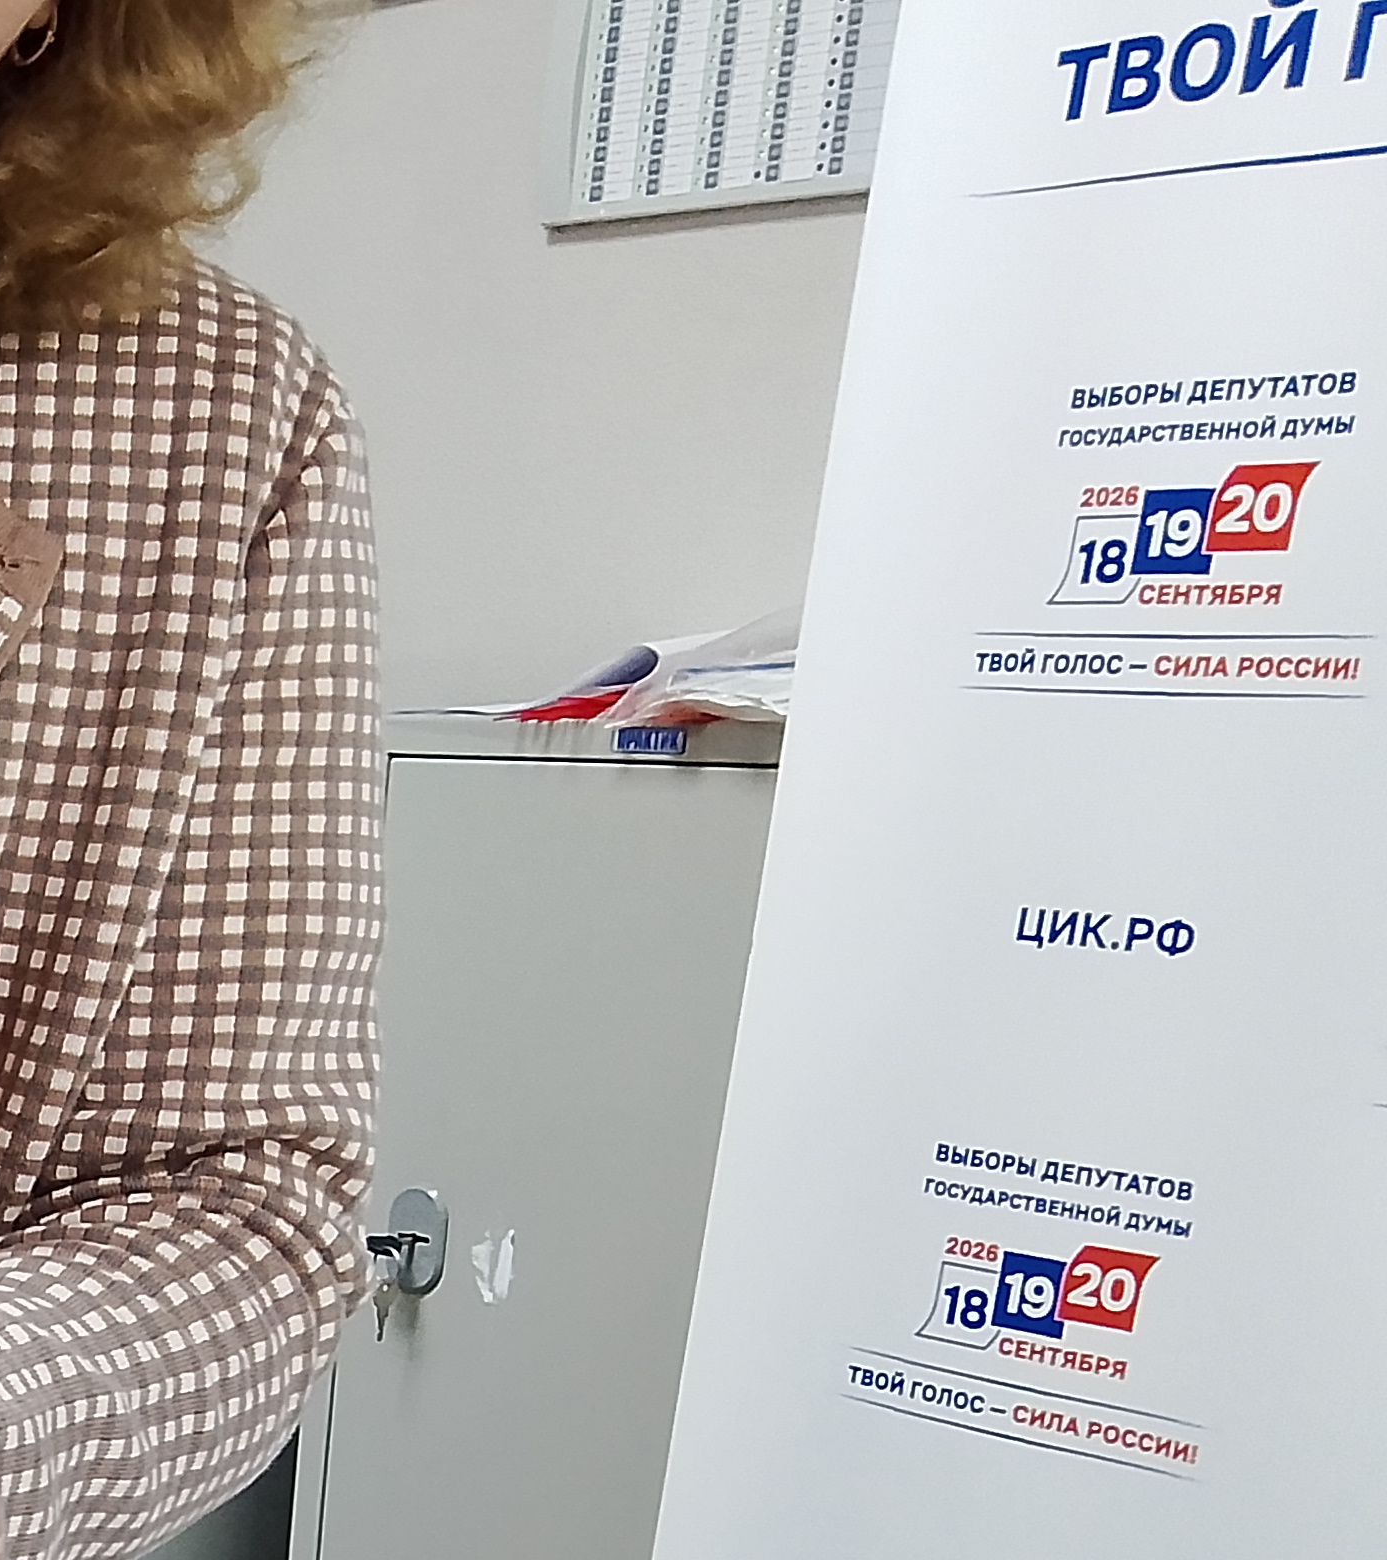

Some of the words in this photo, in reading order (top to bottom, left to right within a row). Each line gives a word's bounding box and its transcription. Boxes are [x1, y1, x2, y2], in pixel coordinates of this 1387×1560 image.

[1057, 0, 1318, 121] ТВОЙ
[1071, 380, 1182, 410] ВЫБОРЫ
[1186, 372, 1357, 406] ДЕПУТАТОВ
[1059, 414, 1276, 447] ГОСУДАРСТВЕННОЙ
[1281, 415, 1355, 441] ДУМЫ
[1081, 485, 1139, 508] 2026
[1078, 540, 1127, 585] 18
[1142, 508, 1201, 559] 19
[1214, 482, 1293, 535] 20
[1138, 583, 1282, 606] СЕНТЯБРЯ
[976, 648, 1034, 674] ТВОЙ
[1040, 653, 1122, 675] ГОЛОС
[1153, 655, 1229, 678] СИЛА
[1236, 656, 1359, 681] РОССИИ!
[1016, 907, 1195, 957] ЦИК.РФ
[936, 1143, 1036, 1177] ВЫБОРЫ
[1041, 1159, 1194, 1201] ДЕПУТАТОВ
[924, 1179, 1120, 1227] ГОСУДАРСТВЕННОЙ
[1124, 1213, 1191, 1238] ДУМЫ
[945, 1238, 999, 1262] 2026
[944, 1286, 989, 1330] 18
[1004, 1274, 1056, 1320] 19
[1066, 1264, 1137, 1312] 20
[998, 1338, 1128, 1380] СЕНТЯБРЯ
[848, 1365, 906, 1396] ТВОЙ
[910, 1381, 985, 1414] ГОЛОС
[1012, 1405, 1080, 1438] СИЛА
[1086, 1421, 1199, 1465] РОССИИ!
